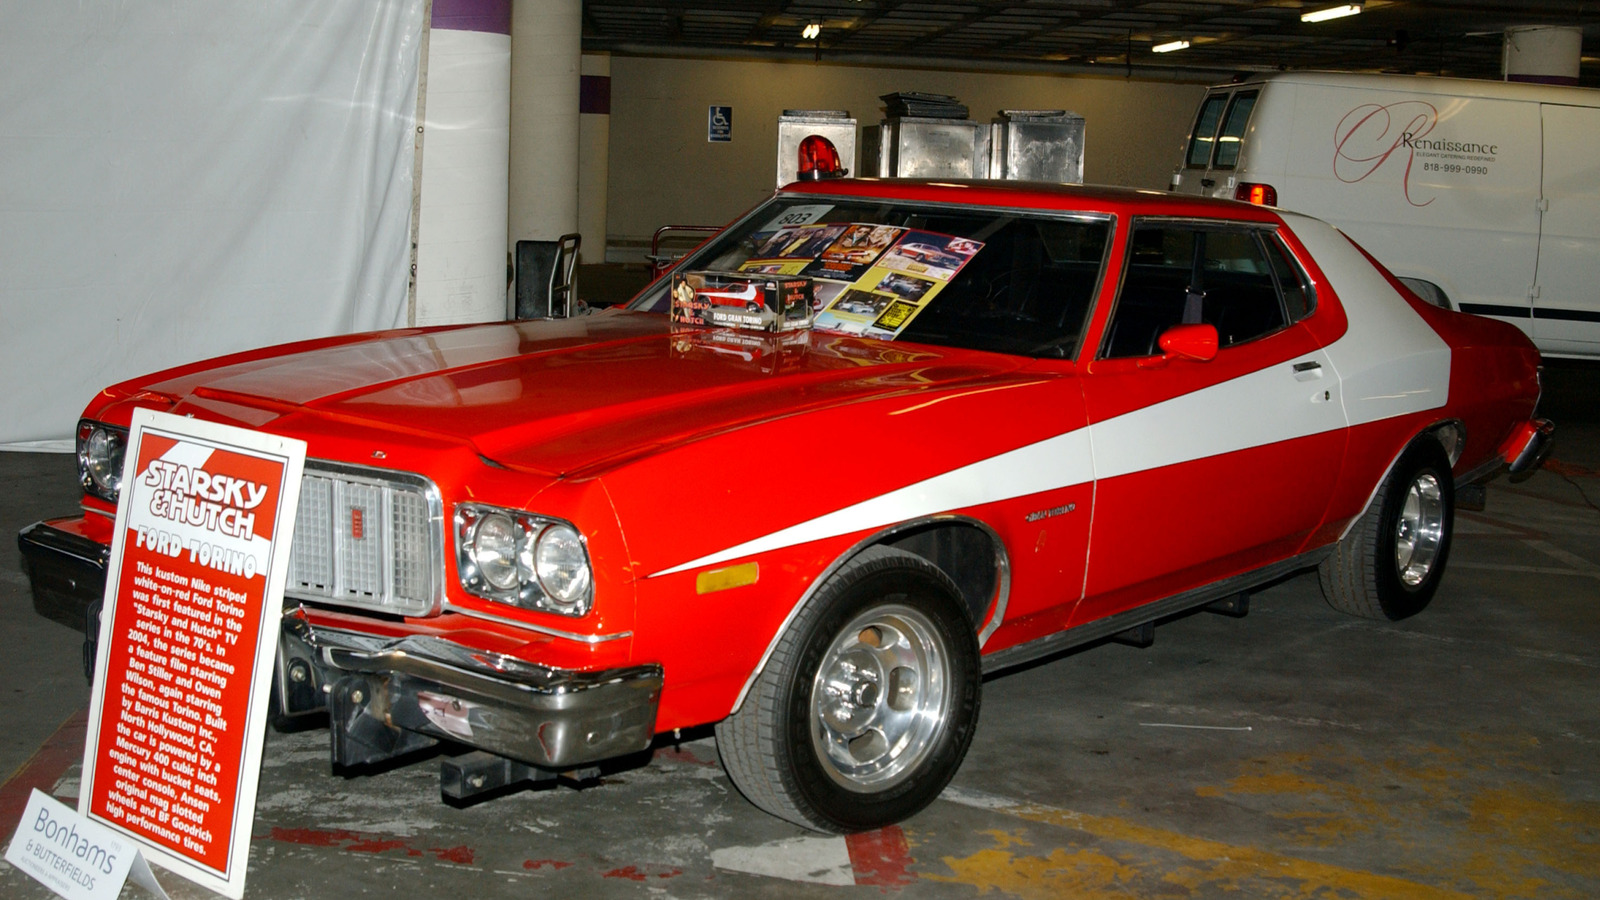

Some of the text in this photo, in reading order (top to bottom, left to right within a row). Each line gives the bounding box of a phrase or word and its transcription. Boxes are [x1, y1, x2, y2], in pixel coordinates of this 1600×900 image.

[1402, 132, 1498, 154] Renaissance
[1424, 162, 1488, 175] 818-999-0990
[778, 213, 812, 224] 803
[713, 312, 762, 325] FORD GRAN TORINO
[145, 459, 268, 509] STARSKY
[136, 525, 258, 579] FORD TORINO
[135, 577, 244, 618] white-on-red Ford Torino
[137, 561, 247, 604] This kustom Nike striped
[133, 590, 242, 632] was first featured in the
[134, 602, 238, 645] "Starsky and Hutch" TV
[128, 629, 235, 674] 2004, the series became
[136, 619, 225, 656] series in the 70's. In
[128, 645, 226, 688] a feature film starring
[129, 657, 221, 699] Ben Stiller and Owen
[122, 683, 227, 731] the famous Torino. Built
[126, 670, 222, 716] Wilson, again starring
[121, 710, 215, 756] North Hollywood, CA,
[122, 696, 217, 743] by Barris Kustom Inc.,
[116, 736, 217, 785] Mercury 400 cubic inch
[117, 723, 220, 772] the car is powered by a
[109, 749, 221, 804] engine with bucket seats,
[114, 765, 209, 812] center console, Ansen
[109, 790, 212, 843] wheels and BF Goodrich
[116, 780, 203, 824] original mag slotted
[34, 807, 116, 875] Bonhams
[106, 801, 206, 855] high performance tires.
[26, 838, 33, 852] &
[34, 843, 96, 891] BUTTERFIELDS
